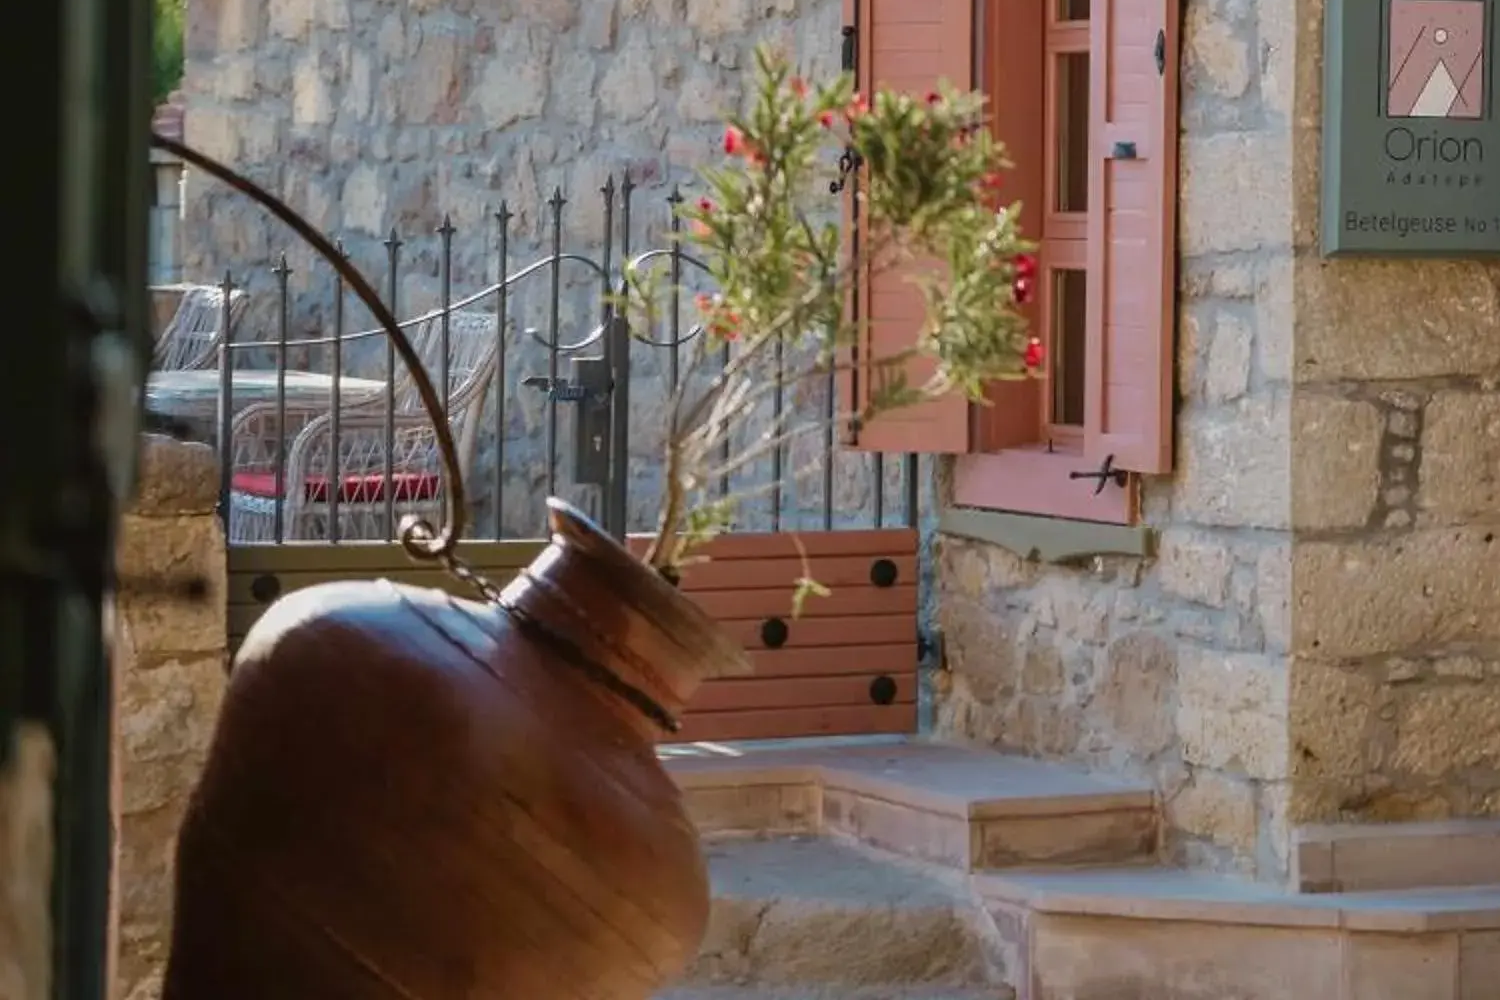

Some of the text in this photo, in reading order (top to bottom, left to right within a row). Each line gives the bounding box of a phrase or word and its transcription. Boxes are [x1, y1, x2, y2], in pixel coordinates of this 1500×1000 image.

[1385, 126, 1484, 163] Orion
[1345, 211, 1457, 238] Betelgeuse
[1464, 216, 1487, 234] No
